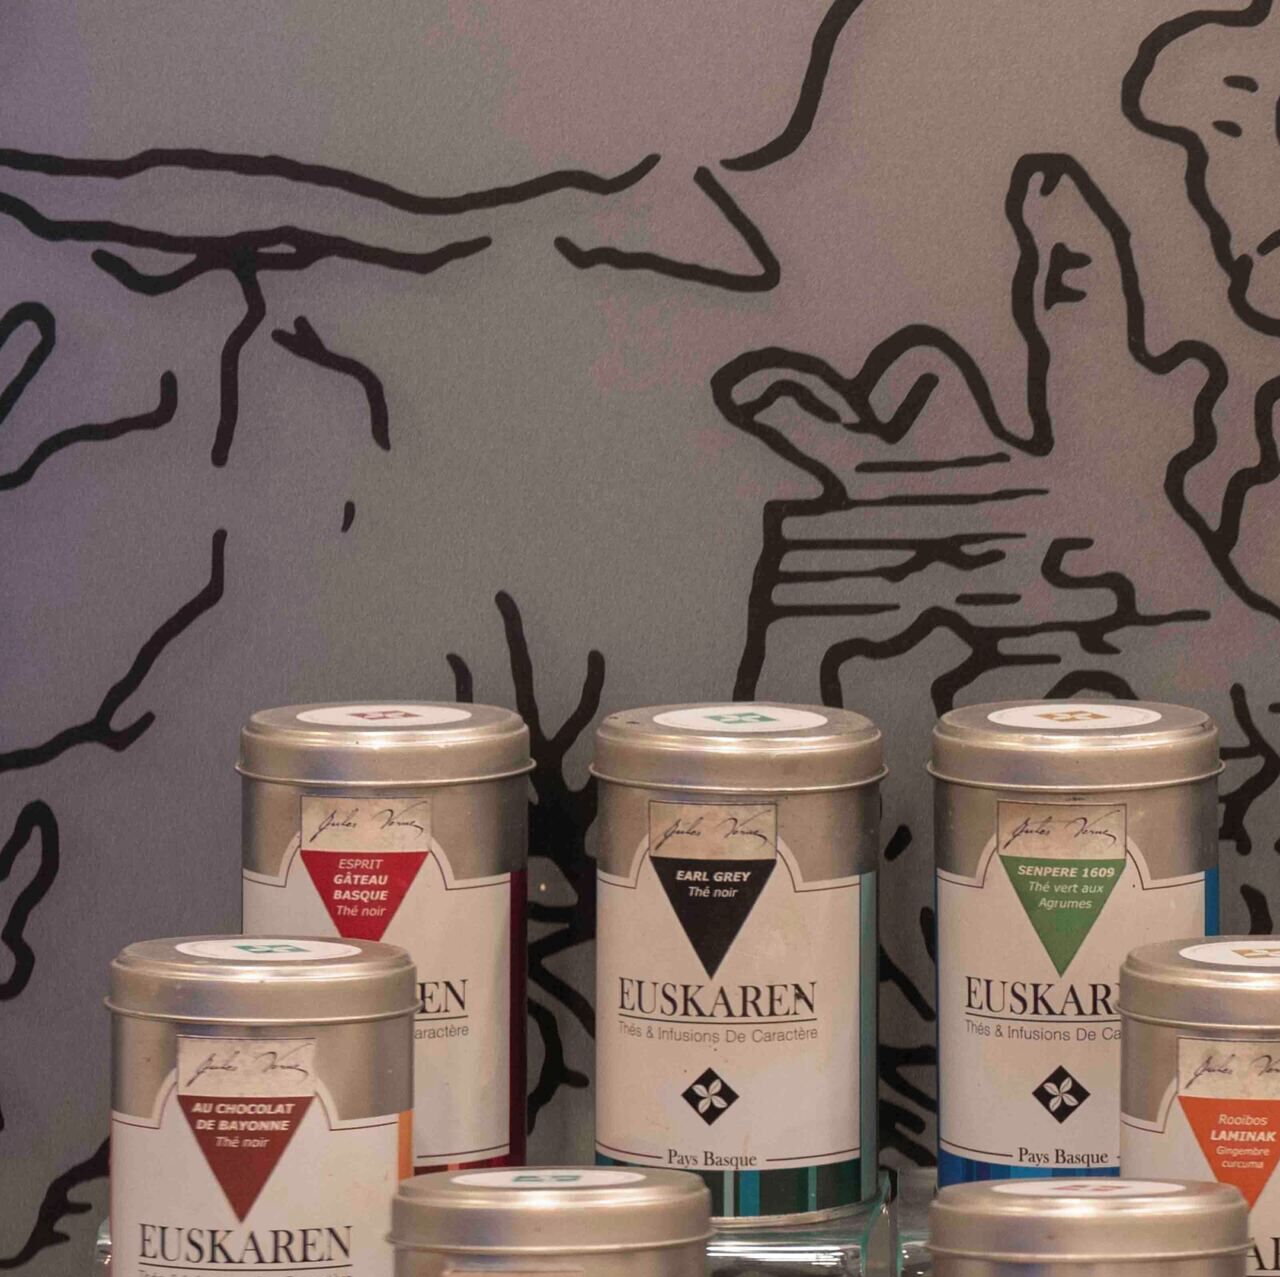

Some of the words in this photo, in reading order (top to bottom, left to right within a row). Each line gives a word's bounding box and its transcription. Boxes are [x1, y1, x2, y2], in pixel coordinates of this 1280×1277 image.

[339, 859, 383, 869] ESPRIT
[676, 870, 709, 881] EARL
[713, 871, 751, 882] GREY
[1017, 865, 1078, 877] SENPERE
[1082, 866, 1115, 878] 1609
[333, 872, 388, 885] GÂTEAU
[688, 885, 710, 897] Thé
[713, 887, 738, 898] noir
[1029, 882, 1050, 893] Thé
[1054, 883, 1078, 894] vert
[1082, 883, 1103, 894] aux
[333, 890, 389, 902] BASQUE
[1039, 897, 1092, 910] Agrumes
[337, 905, 358, 916] Thé
[361, 906, 387, 916] noir
[618, 977, 817, 1017] EUSKAREN
[965, 976, 1120, 1016] EUSKAR
[414, 1024, 469, 1039] aractère
[618, 1020, 642, 1038] Thés
[647, 1027, 654, 1039] &
[658, 1027, 720, 1043] Infusions
[726, 1029, 746, 1043] De
[752, 1027, 818, 1043] Caractère
[966, 1019, 990, 1036] Thés
[995, 1025, 1003, 1038] &
[1008, 1026, 1070, 1041] Infusions
[1077, 1028, 1096, 1040] De
[192, 1103, 210, 1113] AU
[215, 1103, 296, 1114] CHOCOLAT
[196, 1120, 216, 1130] DE
[218, 1120, 291, 1131] BAYONNE
[1218, 1114, 1267, 1126] Rooibos
[216, 1136, 239, 1147] Thé
[241, 1137, 269, 1148] noir
[1210, 1130, 1276, 1142] LAMINAK
[1019, 1147, 1049, 1166] Pays
[1055, 1148, 1108, 1167] Basque
[1217, 1146, 1270, 1158] Gingembre
[668, 1149, 698, 1168] Pays
[704, 1151, 757, 1169] Basque
[1222, 1159, 1263, 1169] curcuma
[138, 1223, 352, 1264] EUSKAREN
